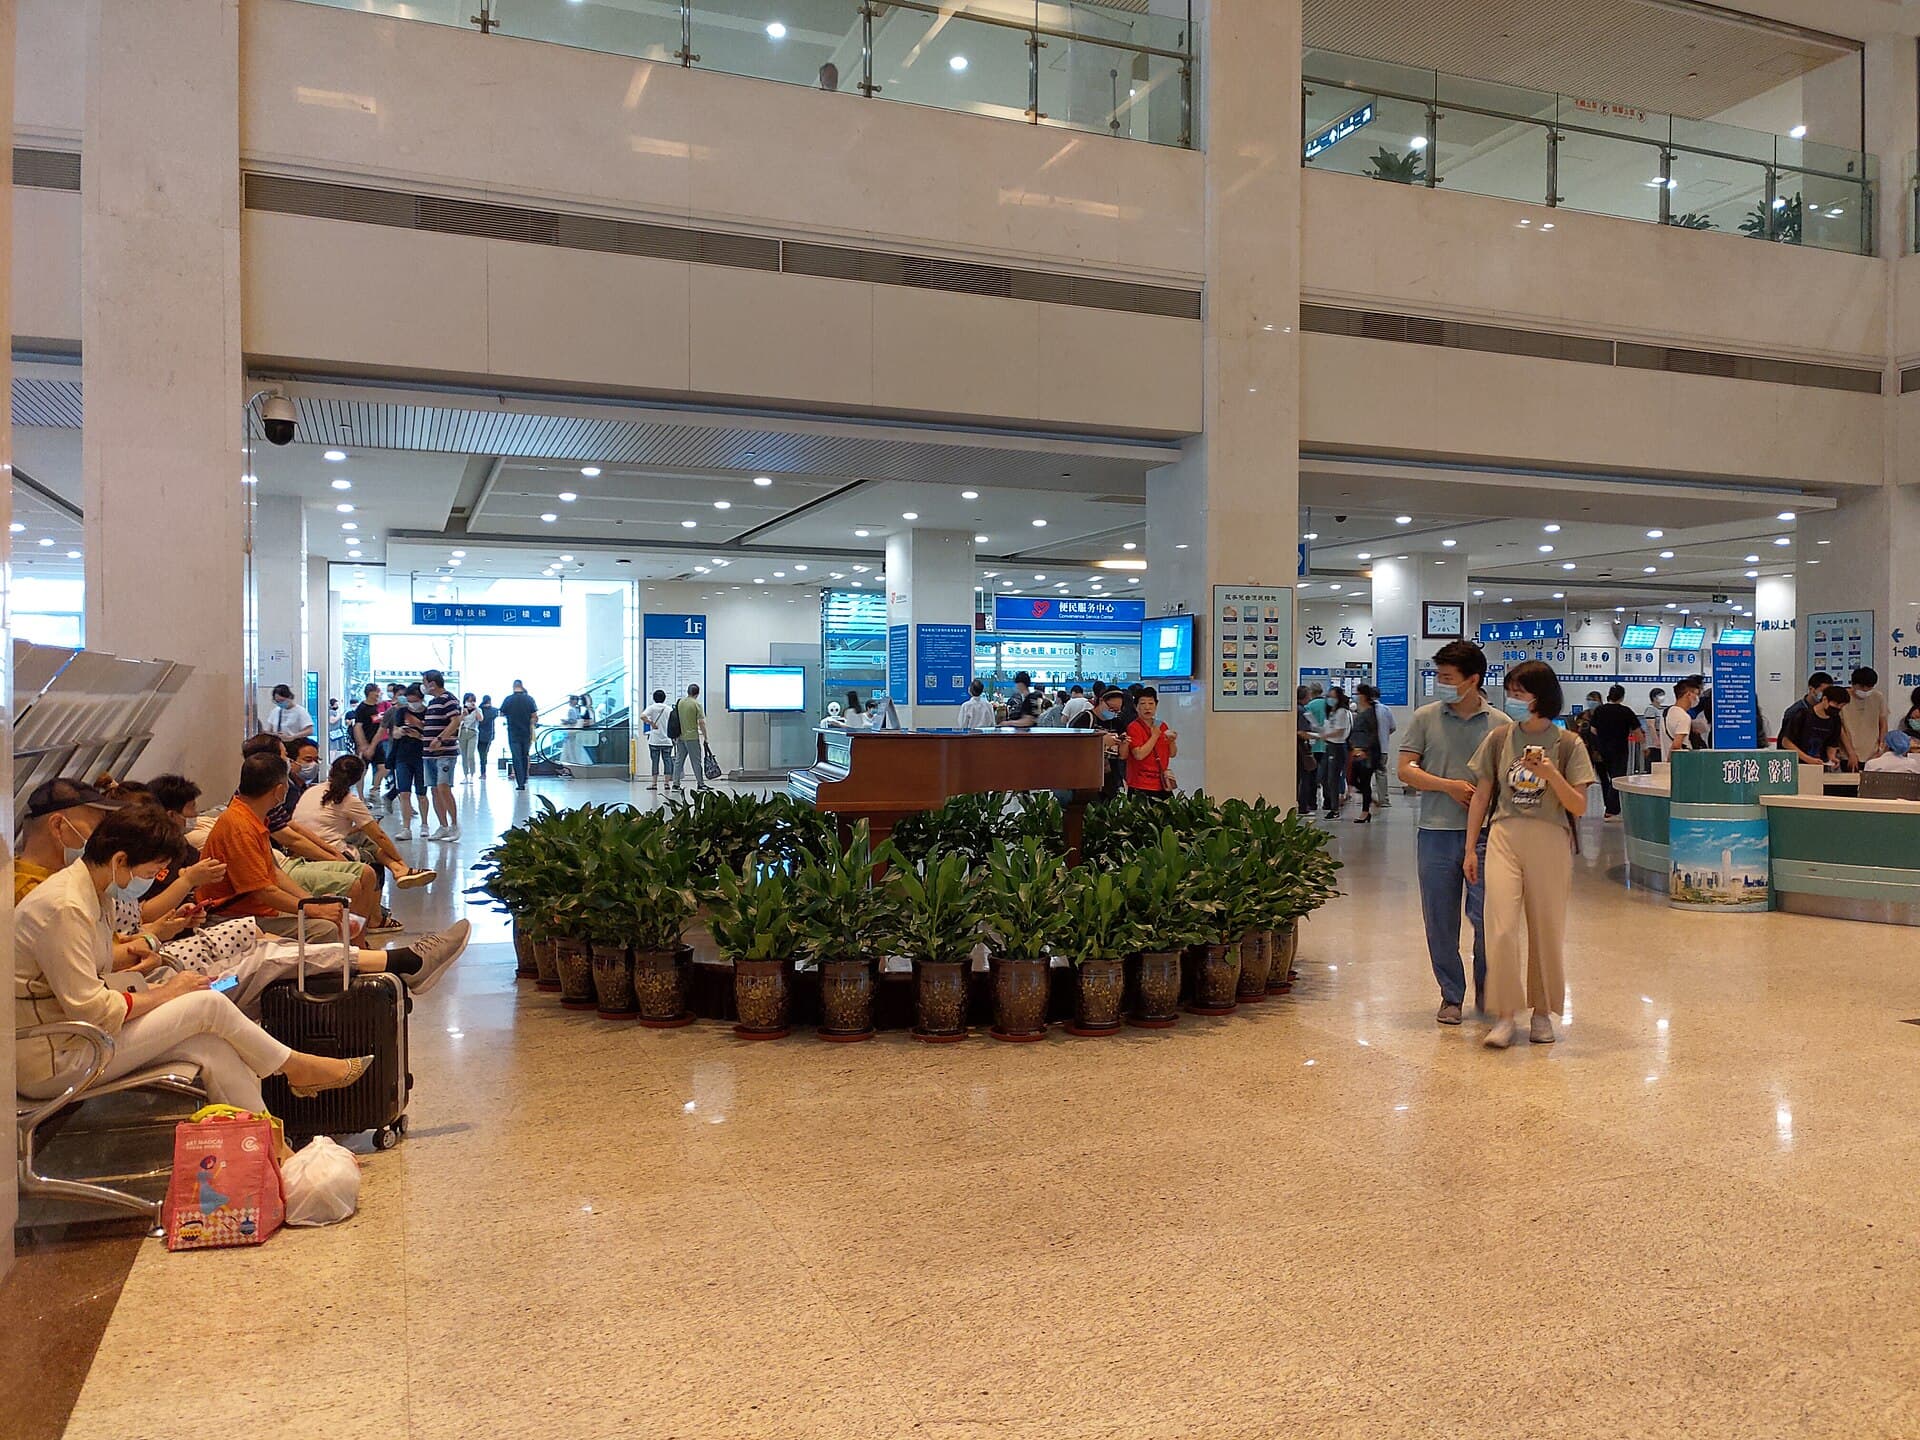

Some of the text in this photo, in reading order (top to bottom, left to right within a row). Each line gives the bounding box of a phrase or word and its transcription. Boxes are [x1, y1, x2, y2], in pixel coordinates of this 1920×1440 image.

[444, 608, 487, 617] 自动扶梯
[1059, 602, 1115, 613] 便民服务中心
[684, 617, 703, 634] 1F
[1892, 645, 1920, 659] 1-6楼
[1722, 758, 1792, 784] 预检 咨询
